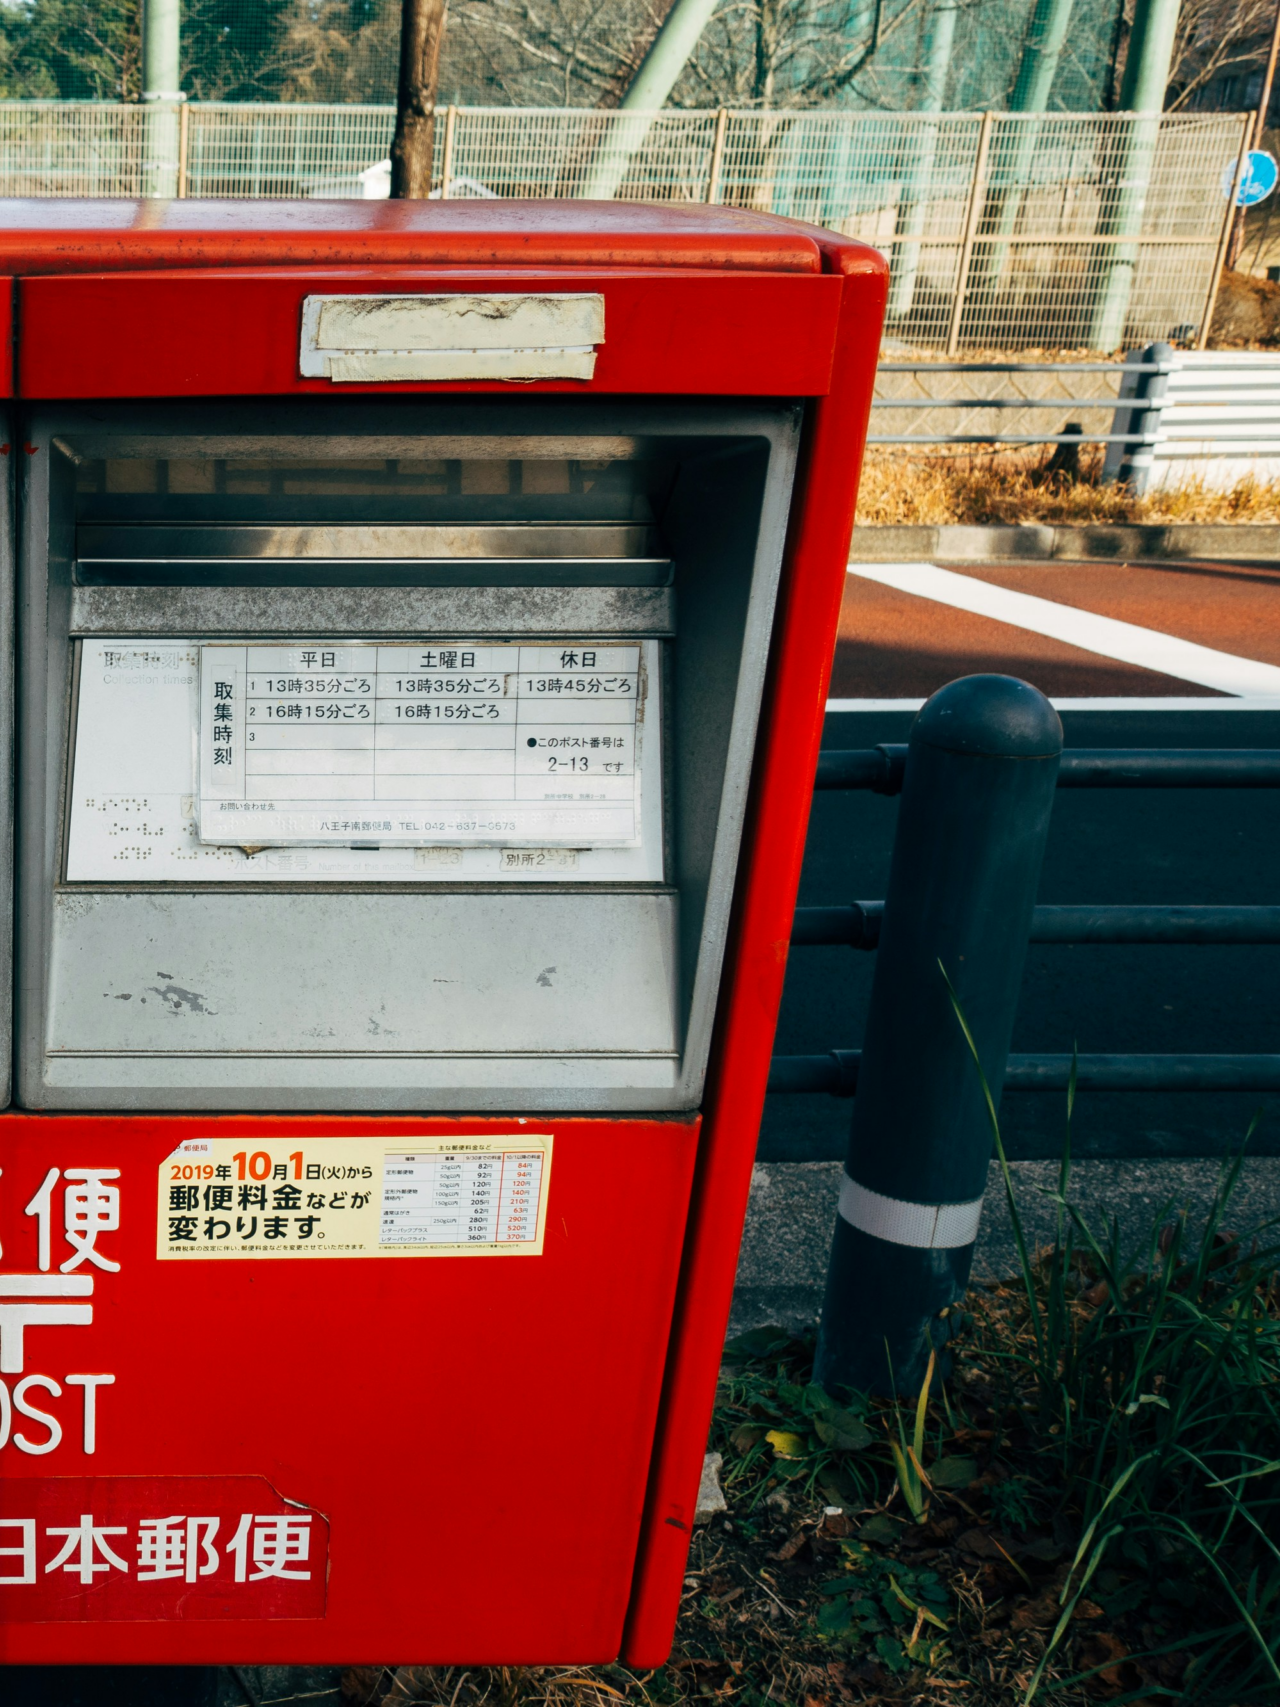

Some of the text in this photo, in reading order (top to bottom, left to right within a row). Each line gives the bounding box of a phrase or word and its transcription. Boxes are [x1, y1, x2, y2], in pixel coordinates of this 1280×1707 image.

[300, 651, 335, 668] 平日
[420, 652, 476, 669] 土曜日
[560, 651, 597, 668] 休日
[266, 678, 371, 693] 13時35分ごろ
[395, 679, 501, 694] 13時35分ごろ
[527, 678, 632, 694] 13時45分ごろ
[266, 704, 370, 719] 16時15分ごろ
[394, 704, 500, 719] 16時15分ごろ
[213, 682, 234, 766] 取集時刻
[602, 762, 624, 773] です
[220, 802, 276, 810] お問い合わせ先
[320, 822, 392, 831] 八王子南郵便局
[398, 822, 420, 830] TEL
[168, 1184, 372, 1212] 郵便料金などが
[168, 1215, 326, 1242] 変わります。
